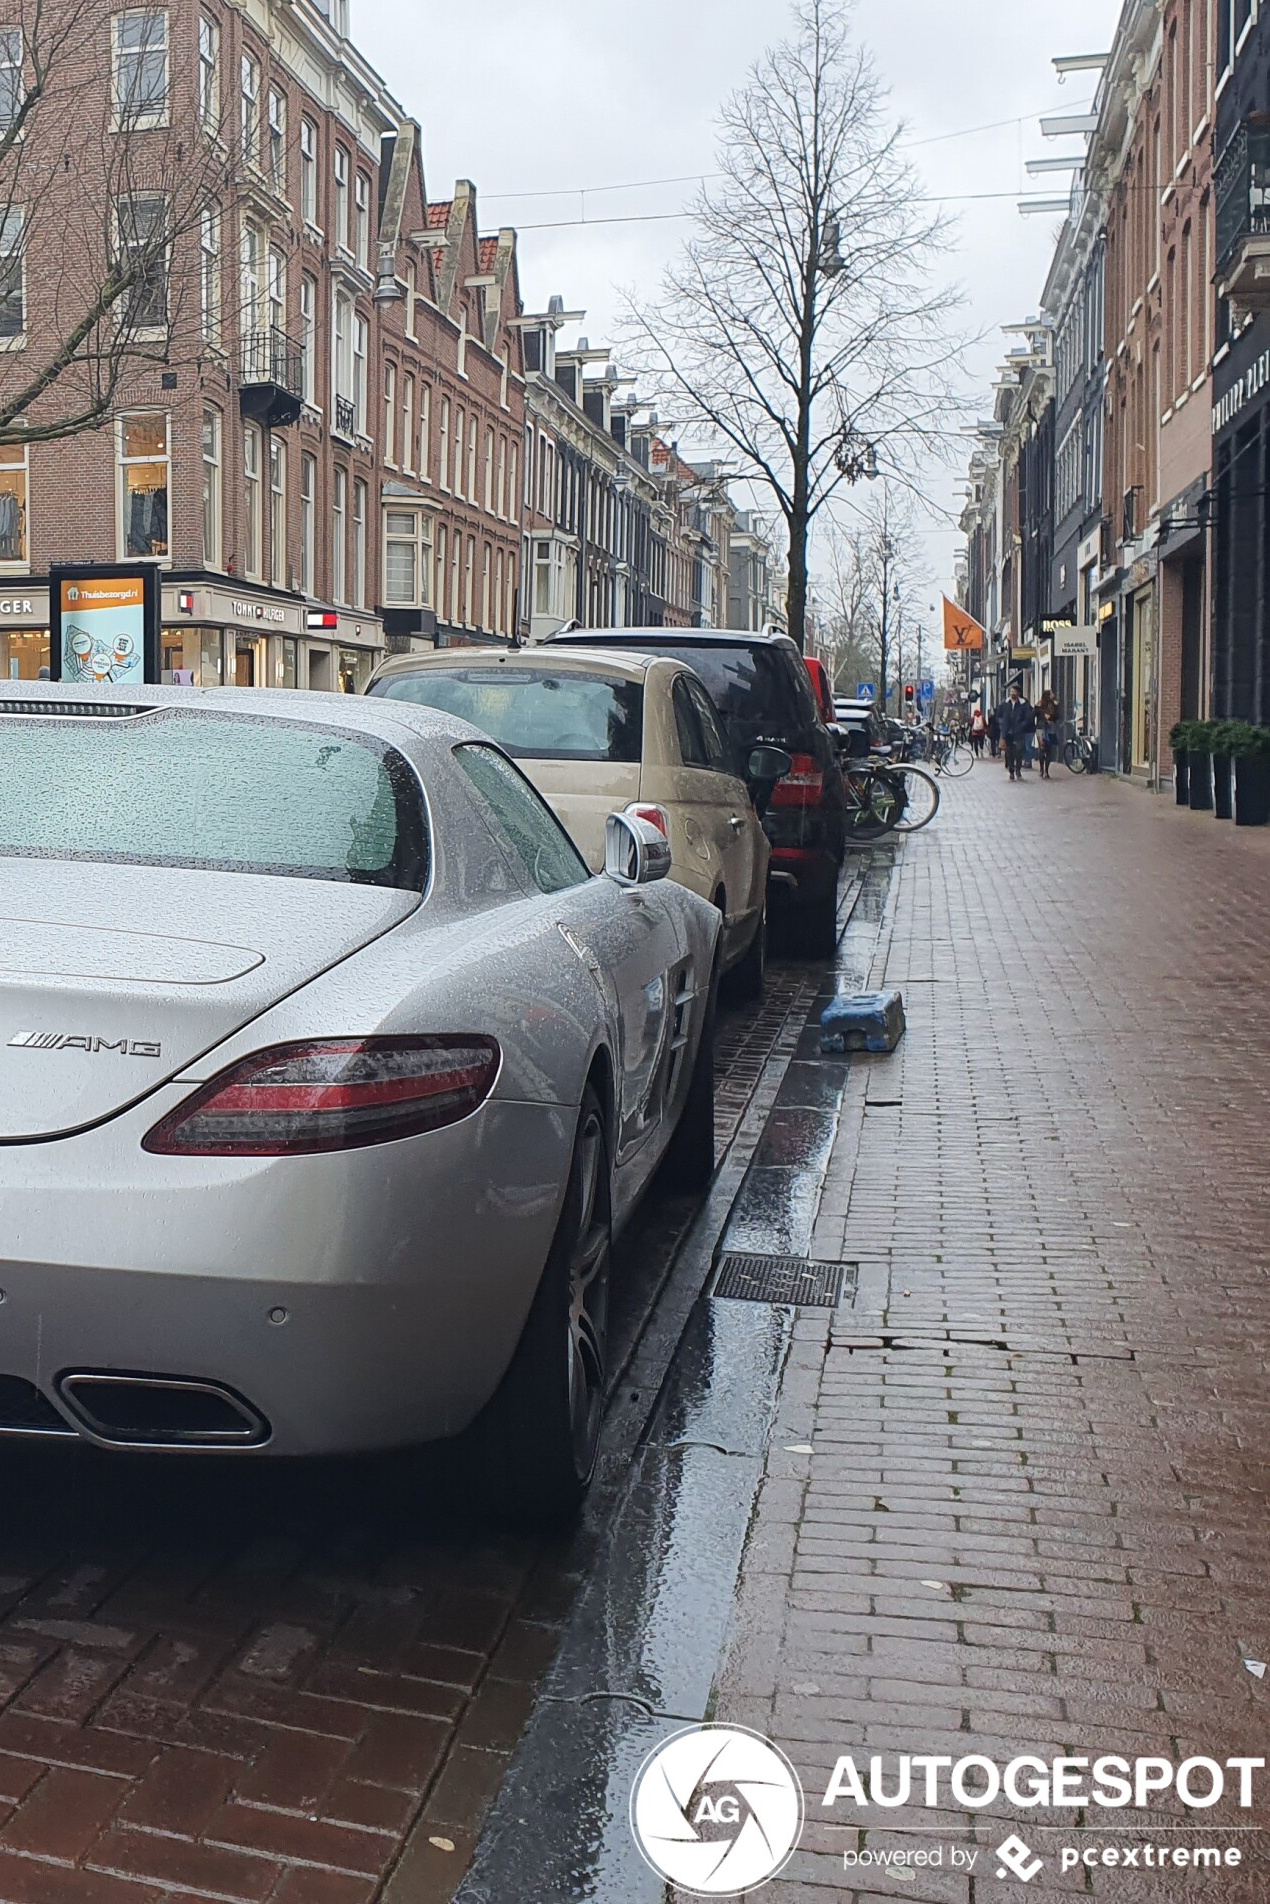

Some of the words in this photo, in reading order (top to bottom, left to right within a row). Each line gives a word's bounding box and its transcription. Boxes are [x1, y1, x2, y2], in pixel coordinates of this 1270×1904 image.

[1212, 377, 1244, 435] PHILIPP
[81, 588, 138, 600] Thuisbezorgd.nl
[232, 601, 256, 618] TOMMY
[1043, 619, 1072, 632] BOSS
[55, 1033, 161, 1057] AMG
